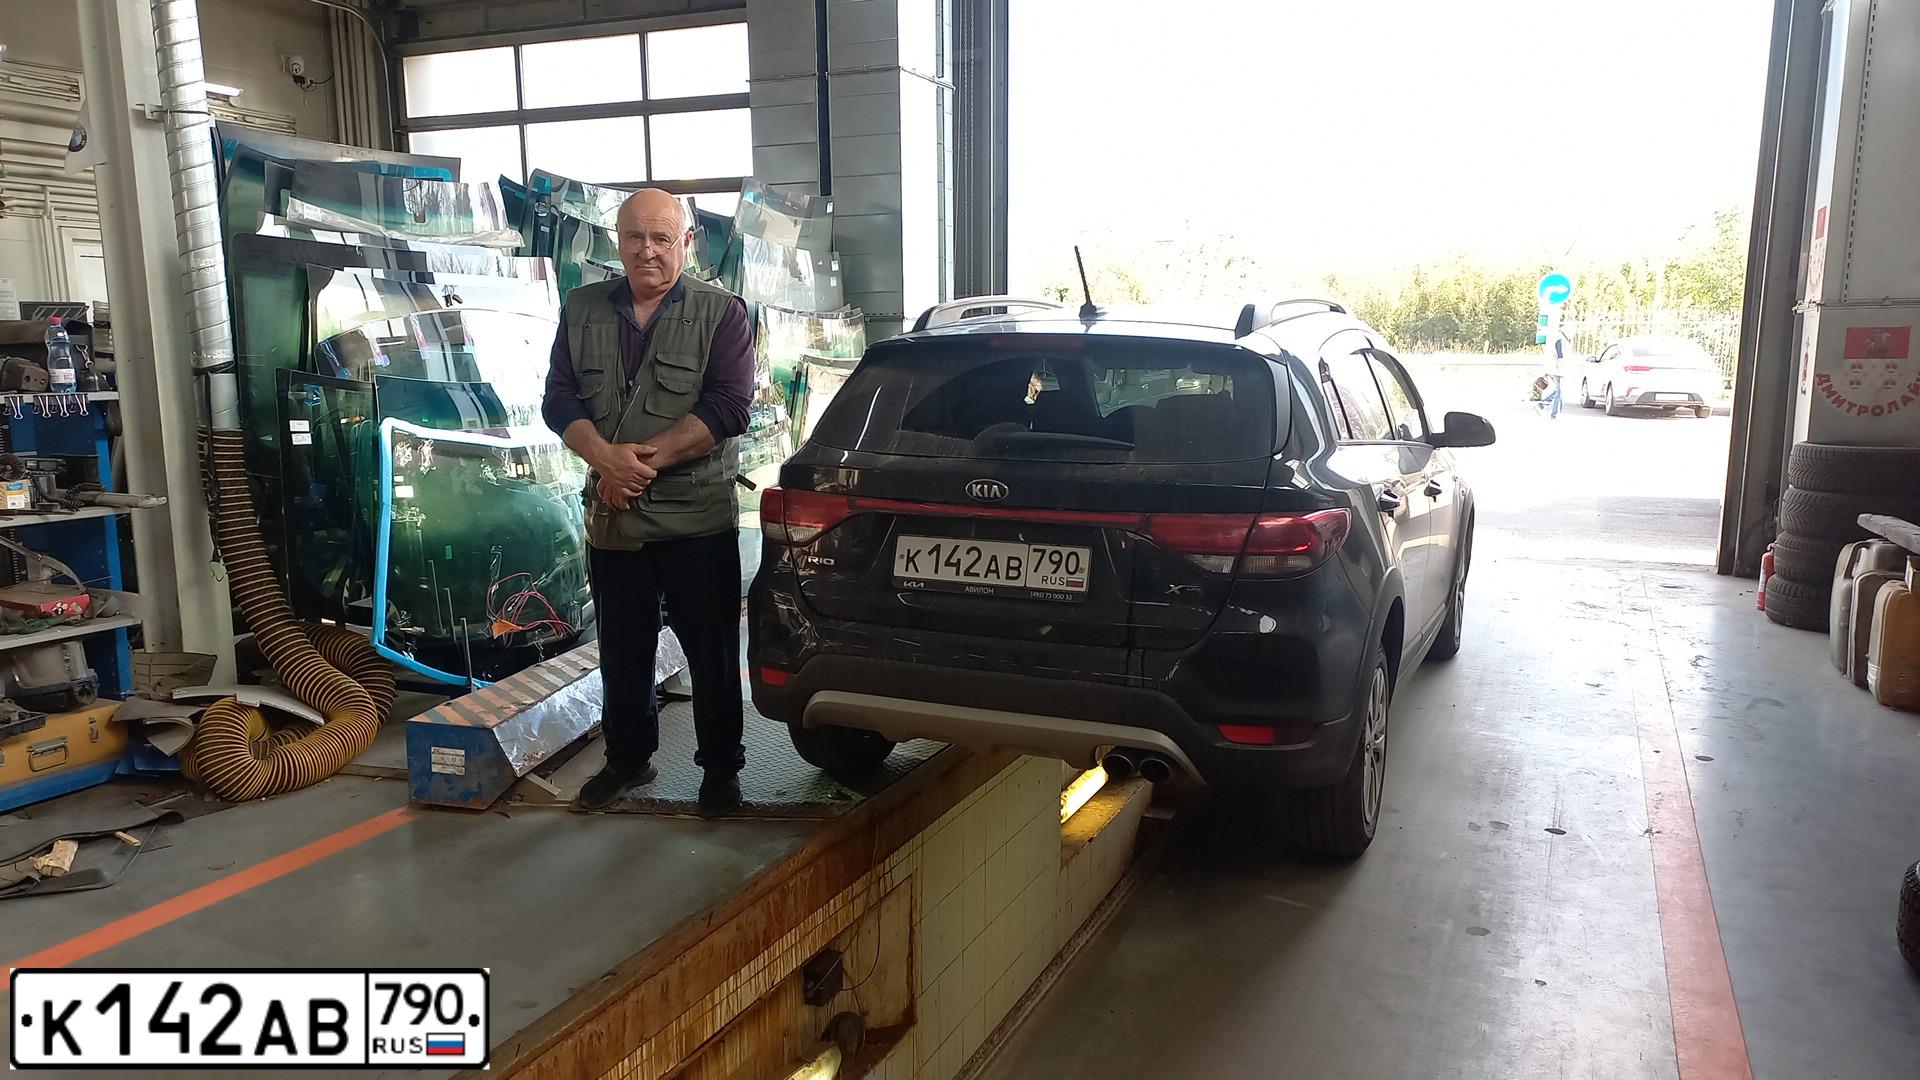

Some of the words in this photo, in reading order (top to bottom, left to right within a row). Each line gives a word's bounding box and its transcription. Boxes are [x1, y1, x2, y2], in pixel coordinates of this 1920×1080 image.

[1815, 371, 1920, 416] ДМИТРОЛАЙ
[971, 484, 1002, 498] KIA
[807, 556, 835, 566] RIO
[904, 543, 1022, 581] К142АВ
[1032, 548, 1080, 576] 790
[1041, 575, 1065, 586] RUS
[964, 585, 995, 595] АВИЛОН
